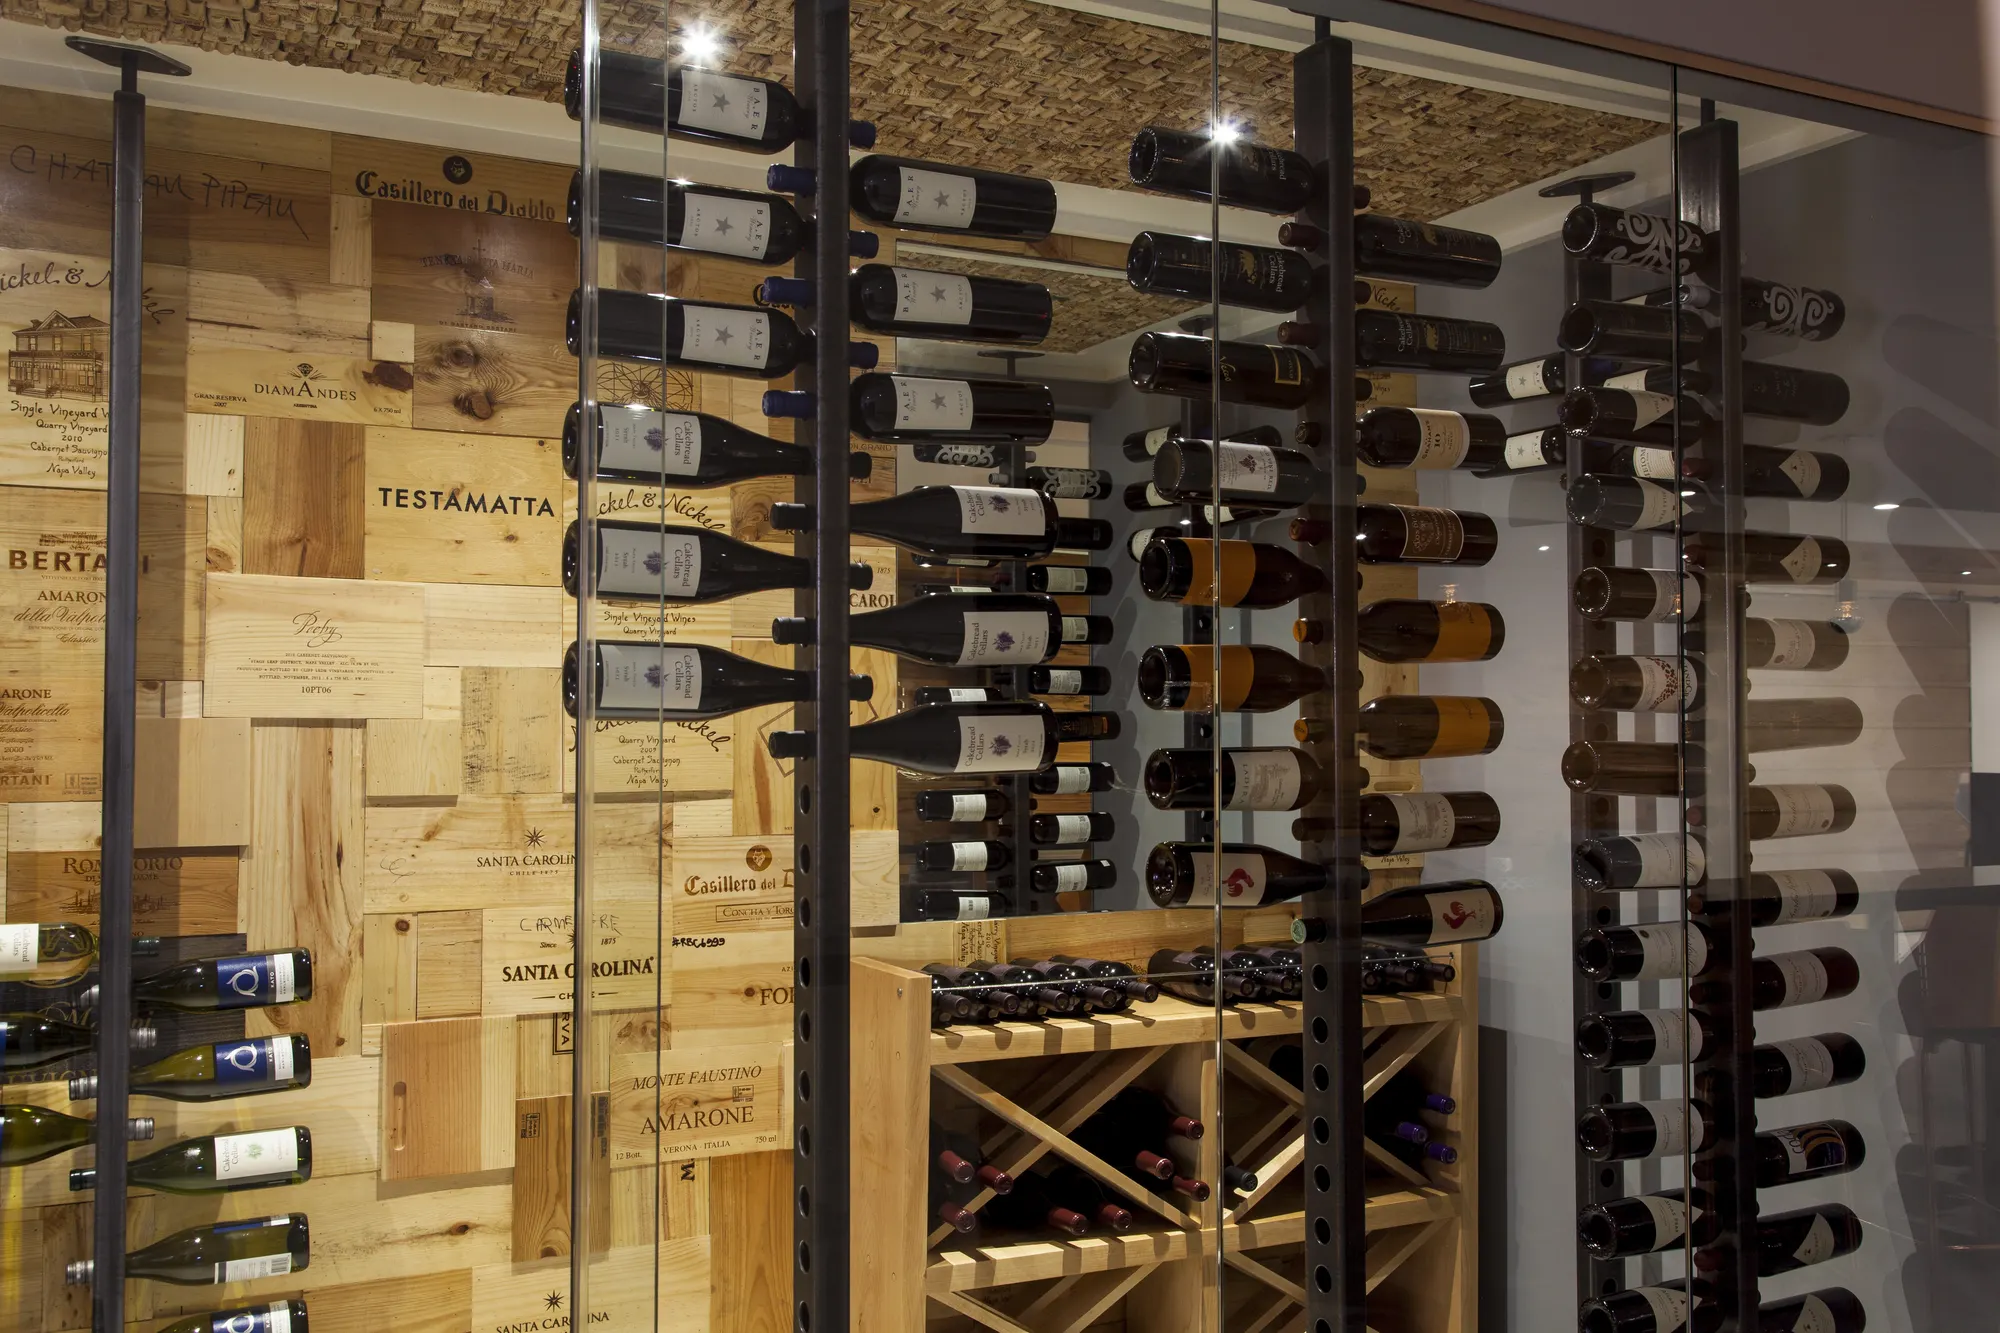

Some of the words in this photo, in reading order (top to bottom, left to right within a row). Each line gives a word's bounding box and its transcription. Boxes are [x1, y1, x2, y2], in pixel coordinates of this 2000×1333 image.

[10, 145, 194, 201] CHATAU
[202, 172, 309, 240] PIPEAU
[355, 169, 453, 208] Casillero
[459, 194, 479, 211] del
[485, 190, 556, 222] Diablo
[0, 261, 60, 293] ickel
[194, 391, 214, 401] GRAN
[216, 393, 248, 403] RESERVA
[254, 380, 357, 401] DIAMANDES
[10, 400, 43, 418] Single
[50, 403, 98, 421] Vineyard
[36, 418, 68, 434] Quarry
[70, 422, 108, 435] Vineyard
[30, 441, 69, 456] Cabernet
[71, 444, 108, 459] Sauvigno
[61, 435, 83, 443] 2010
[674, 426, 683, 456] Cellars
[683, 420, 692, 465] Cakebread
[46, 462, 70, 478] Napa
[72, 465, 96, 479] Valley
[377, 486, 555, 518] TESTAMATTA
[642, 492, 656, 508] &
[658, 493, 725, 530] Nickel
[9, 549, 149, 574] BERTAI
[673, 549, 683, 579] Cellars
[682, 542, 692, 587] Cakebread
[876, 566, 891, 575] 1875
[37, 590, 106, 604] AMARON
[292, 610, 343, 648] Poetry
[604, 610, 629, 625] Single
[633, 612, 668, 627] Vineyad
[671, 612, 696, 626] Wines
[622, 626, 648, 637] Quarry
[967, 621, 980, 662] Cakebread
[978, 629, 989, 657] Cellars
[674, 660, 682, 691] Cellars
[683, 654, 692, 699] Cakebread
[0, 689, 52, 700] ARONE
[301, 685, 332, 694] 10PT06
[618, 735, 645, 748] Quarry
[965, 726, 975, 767] Cakebread
[975, 733, 984, 761] Cellars
[613, 755, 645, 765] Cabernet
[633, 766, 661, 774] Rutherfor
[0, 774, 51, 786] RTANI
[626, 775, 647, 787] Napa
[476, 856, 519, 868] SANTA
[523, 854, 576, 866] CAROLIN
[684, 874, 757, 897] Casillero
[761, 877, 776, 891] del
[722, 907, 763, 918] CONCHA
[539, 941, 558, 949] Since
[600, 937, 617, 946] 1875
[502, 964, 559, 983] SANTA
[564, 957, 654, 979] CROLINA
[632, 1071, 685, 1091] MONTE
[688, 1065, 762, 1085] FAUSTINO
[640, 1105, 755, 1135] AMARONE
[615, 1152, 624, 1161] 12
[625, 1151, 643, 1160] Bott.
[663, 1143, 698, 1154] VERONA
[704, 1140, 731, 1150] ITALIA
[754, 1135, 768, 1144] 750
[768, 1134, 777, 1143] ml
[496, 1321, 539, 1333] SANTA
